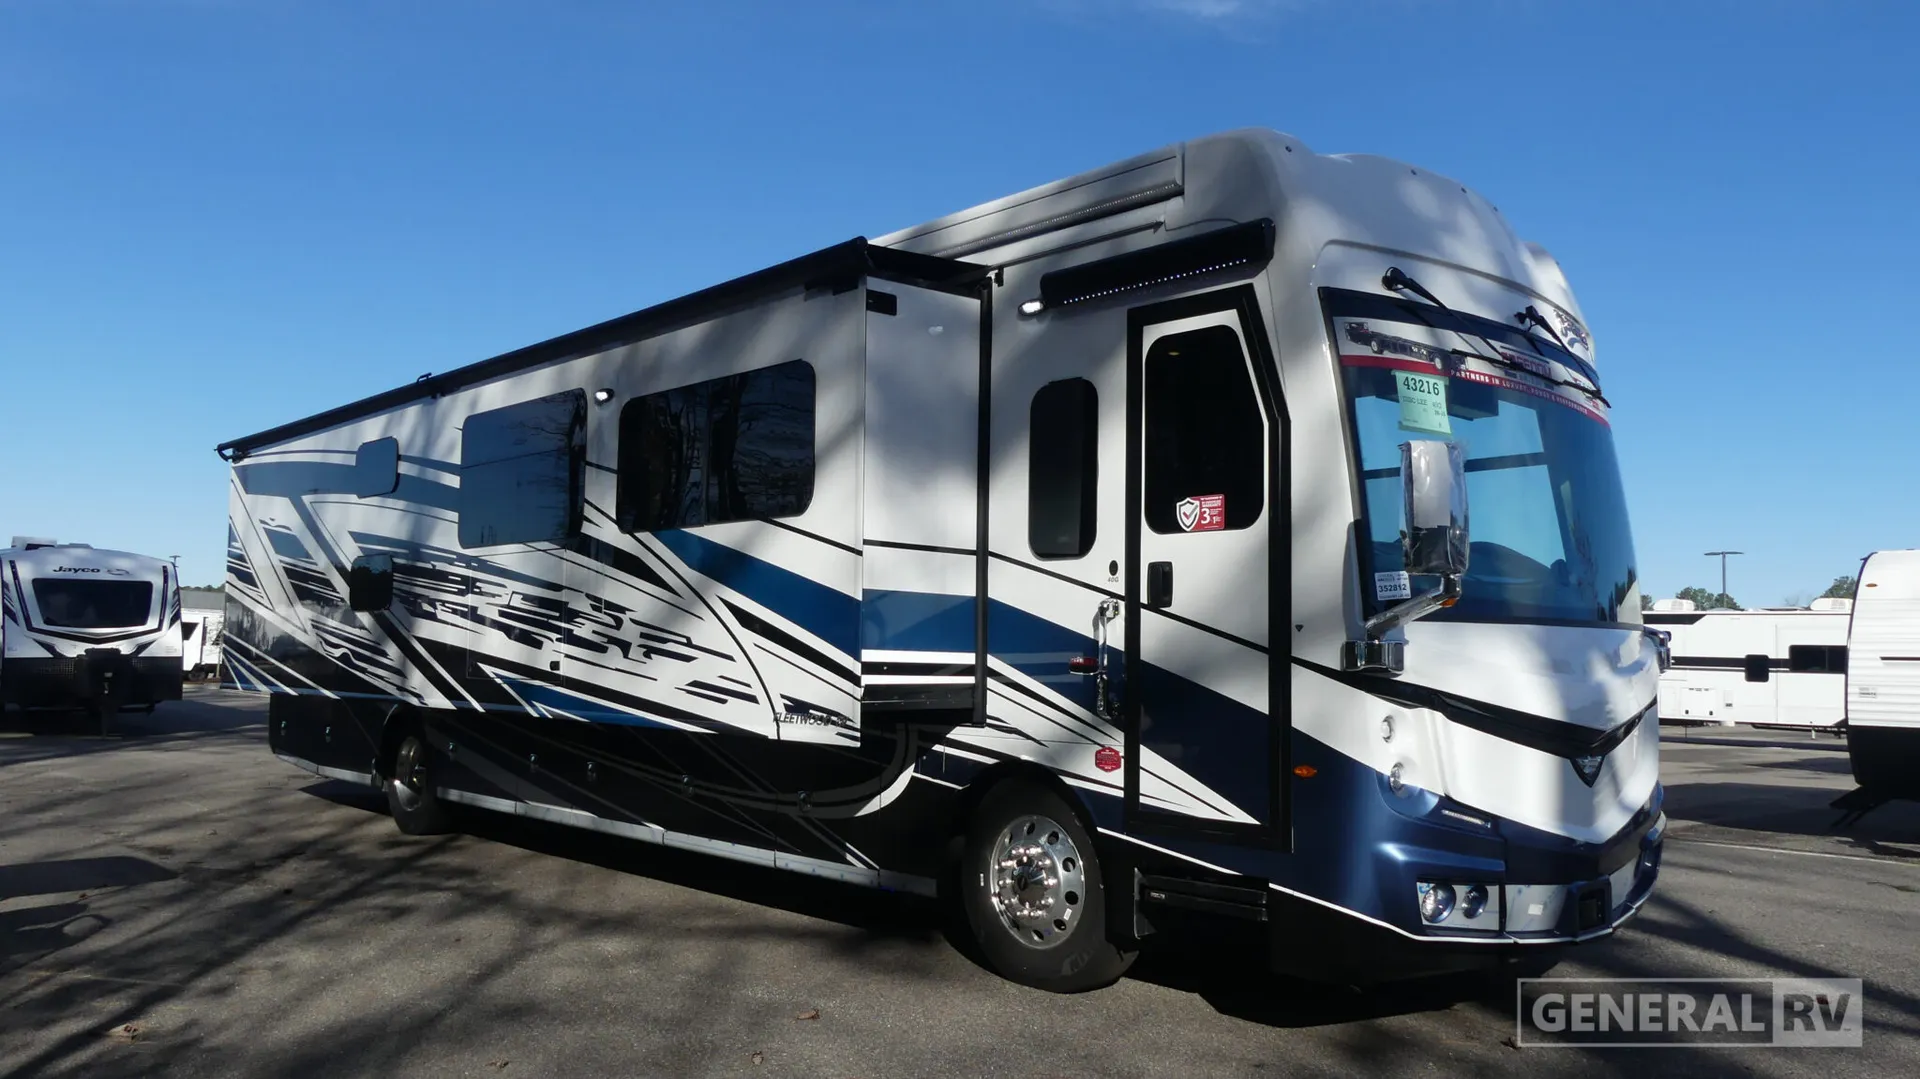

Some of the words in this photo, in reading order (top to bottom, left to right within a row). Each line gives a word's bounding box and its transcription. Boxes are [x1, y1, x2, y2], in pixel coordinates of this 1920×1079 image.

[1451, 369, 1489, 383] PARTNERS
[1492, 377, 1500, 385] IN
[1403, 376, 1439, 396] 43216
[1201, 507, 1210, 524] 3
[53, 566, 100, 574] Jayco
[1378, 583, 1407, 593] 352812
[773, 712, 831, 726] FLEETWOOD
